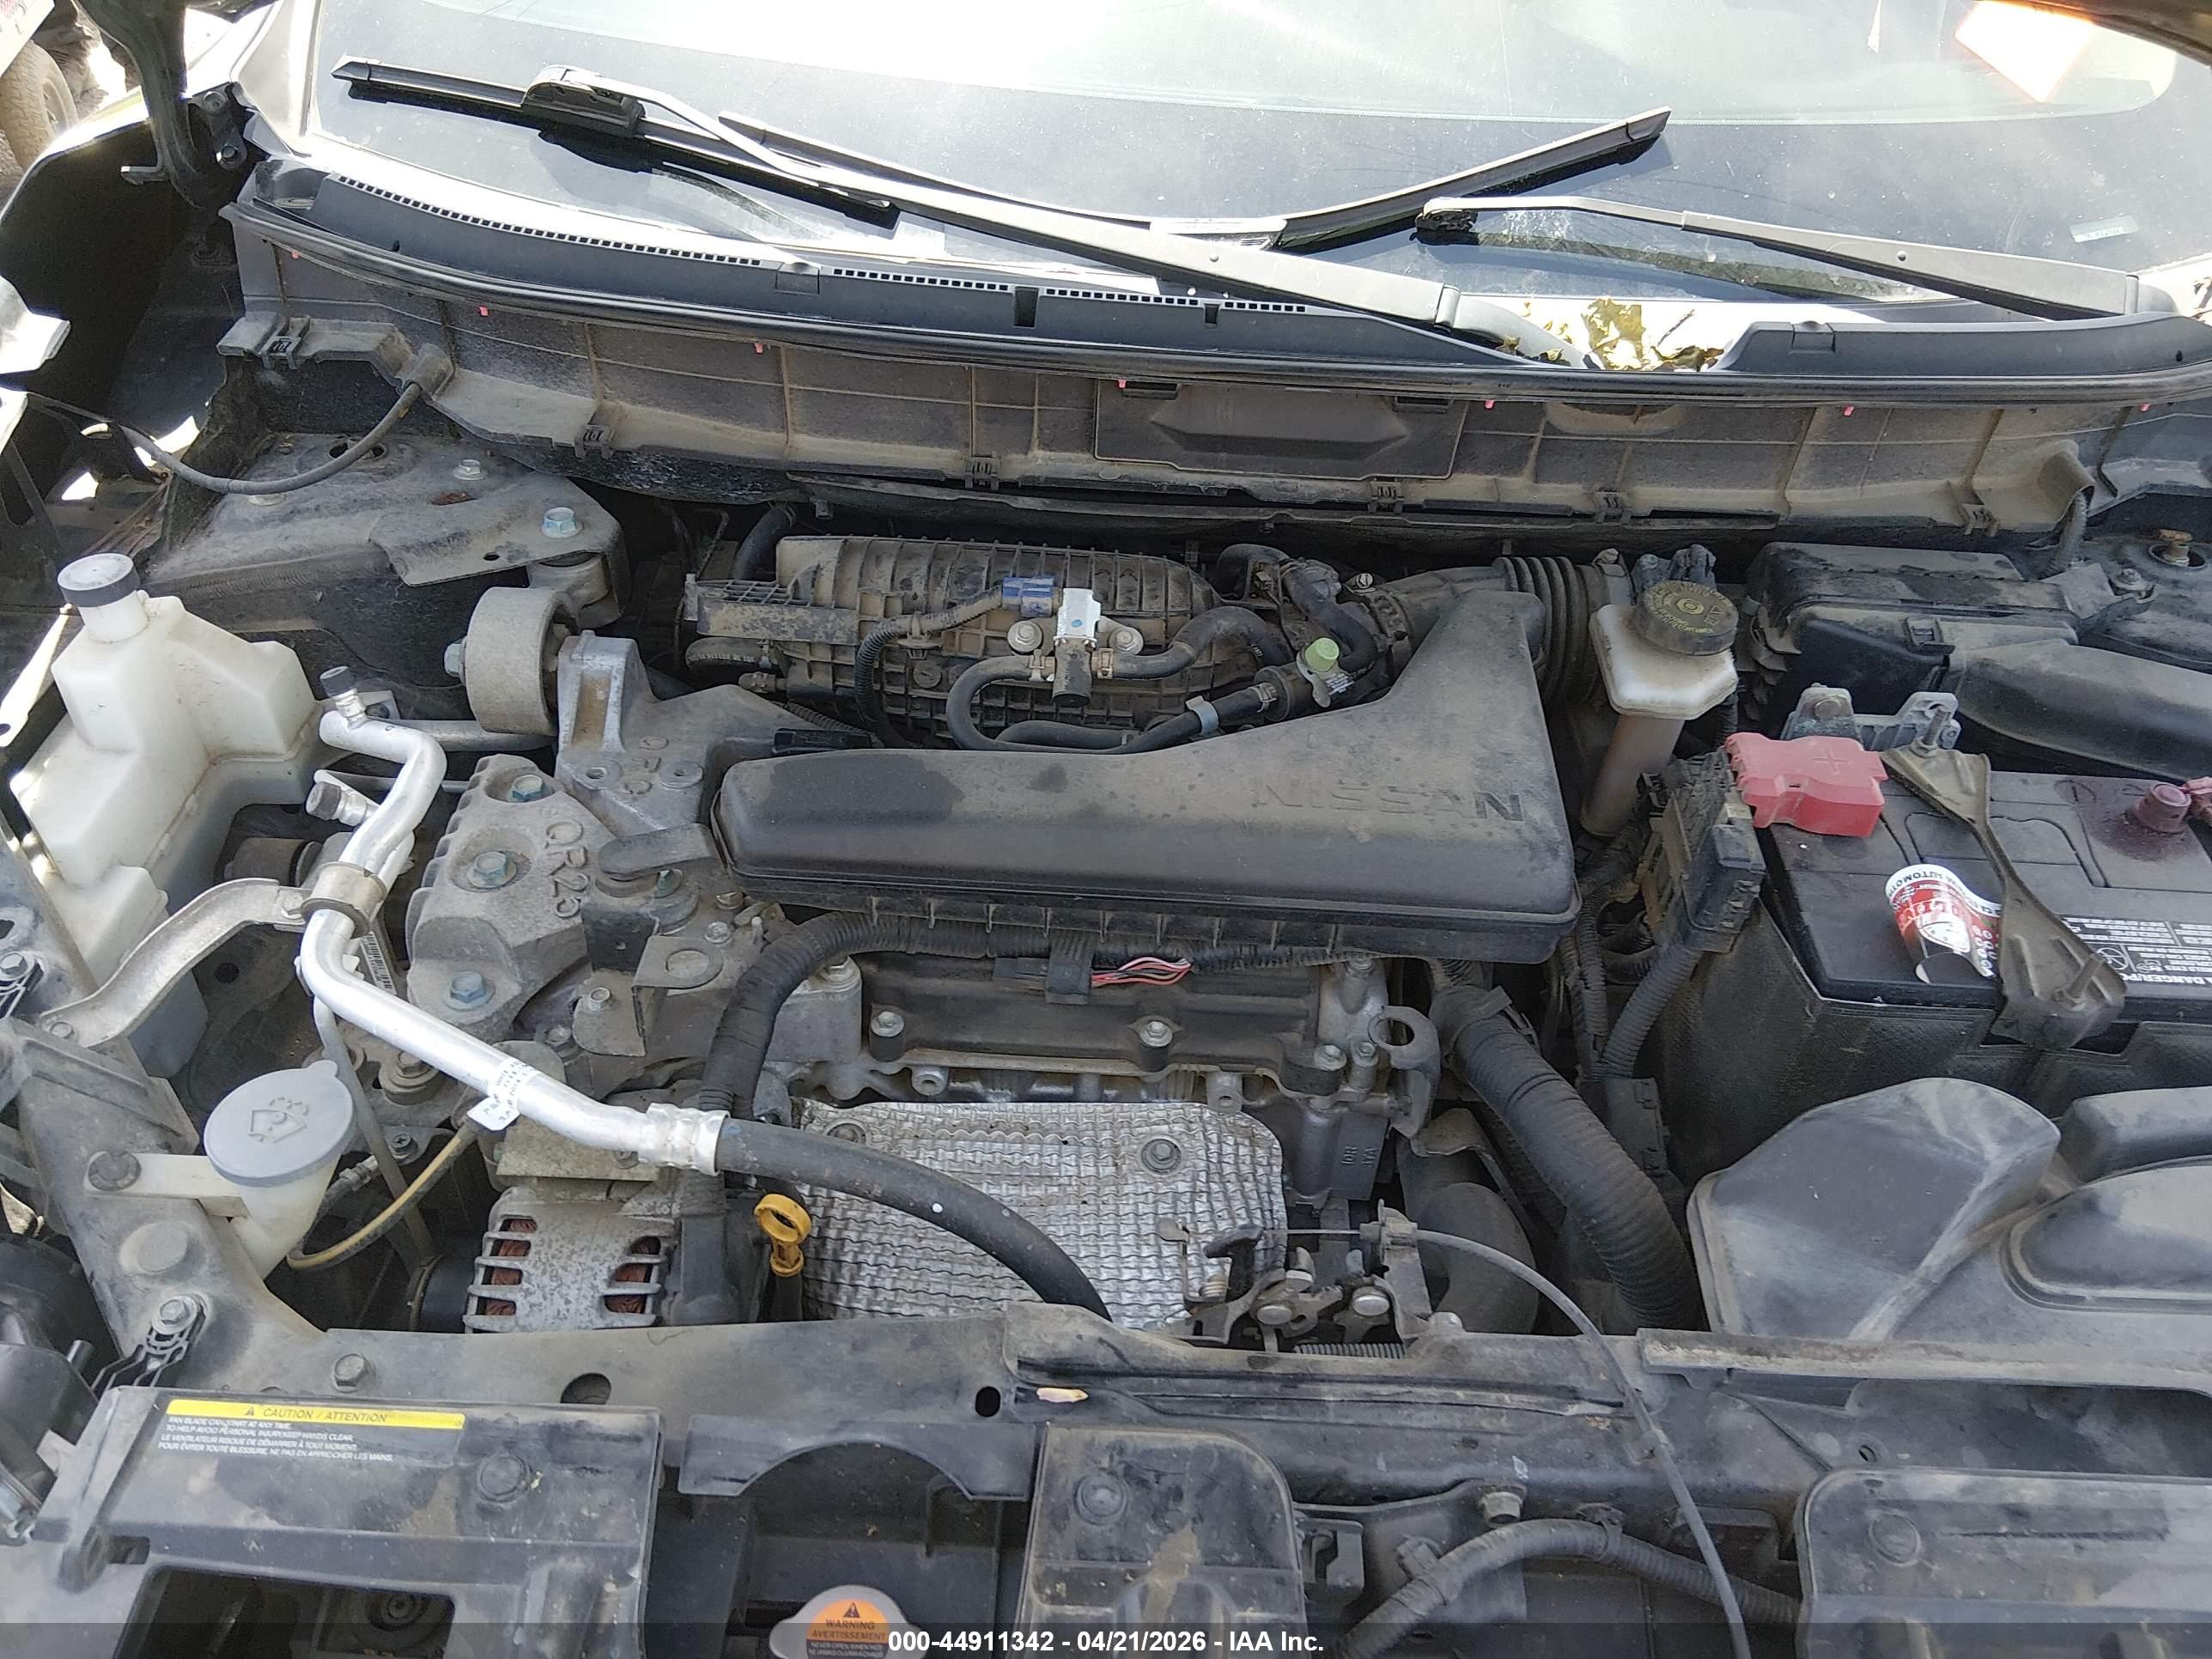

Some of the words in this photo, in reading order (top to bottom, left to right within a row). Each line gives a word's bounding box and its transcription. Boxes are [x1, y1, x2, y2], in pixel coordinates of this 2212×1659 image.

[543, 820, 591, 920] QR25
[263, 1407, 314, 1419] CAUTION
[325, 1410, 386, 1423] ATTENTION
[219, 1427, 257, 1437] PERSONAL
[301, 1432, 327, 1441] HANDS
[172, 1435, 218, 1443] VENTILATEUR
[218, 1437, 246, 1445] RISQUE
[304, 1442, 324, 1450] TOUT
[158, 1442, 179, 1450] POUR
[179, 1441, 205, 1451] ÉVITER
[205, 1444, 228, 1453] TOUTE
[269, 1448, 281, 1456] NE
[281, 1449, 296, 1457] PAS
[307, 1450, 353, 1460] APPROCHER
[353, 1452, 368, 1461] LES
[824, 1619, 875, 1631] WARNING
[811, 1629, 886, 1641] AVERTISSEMENT
